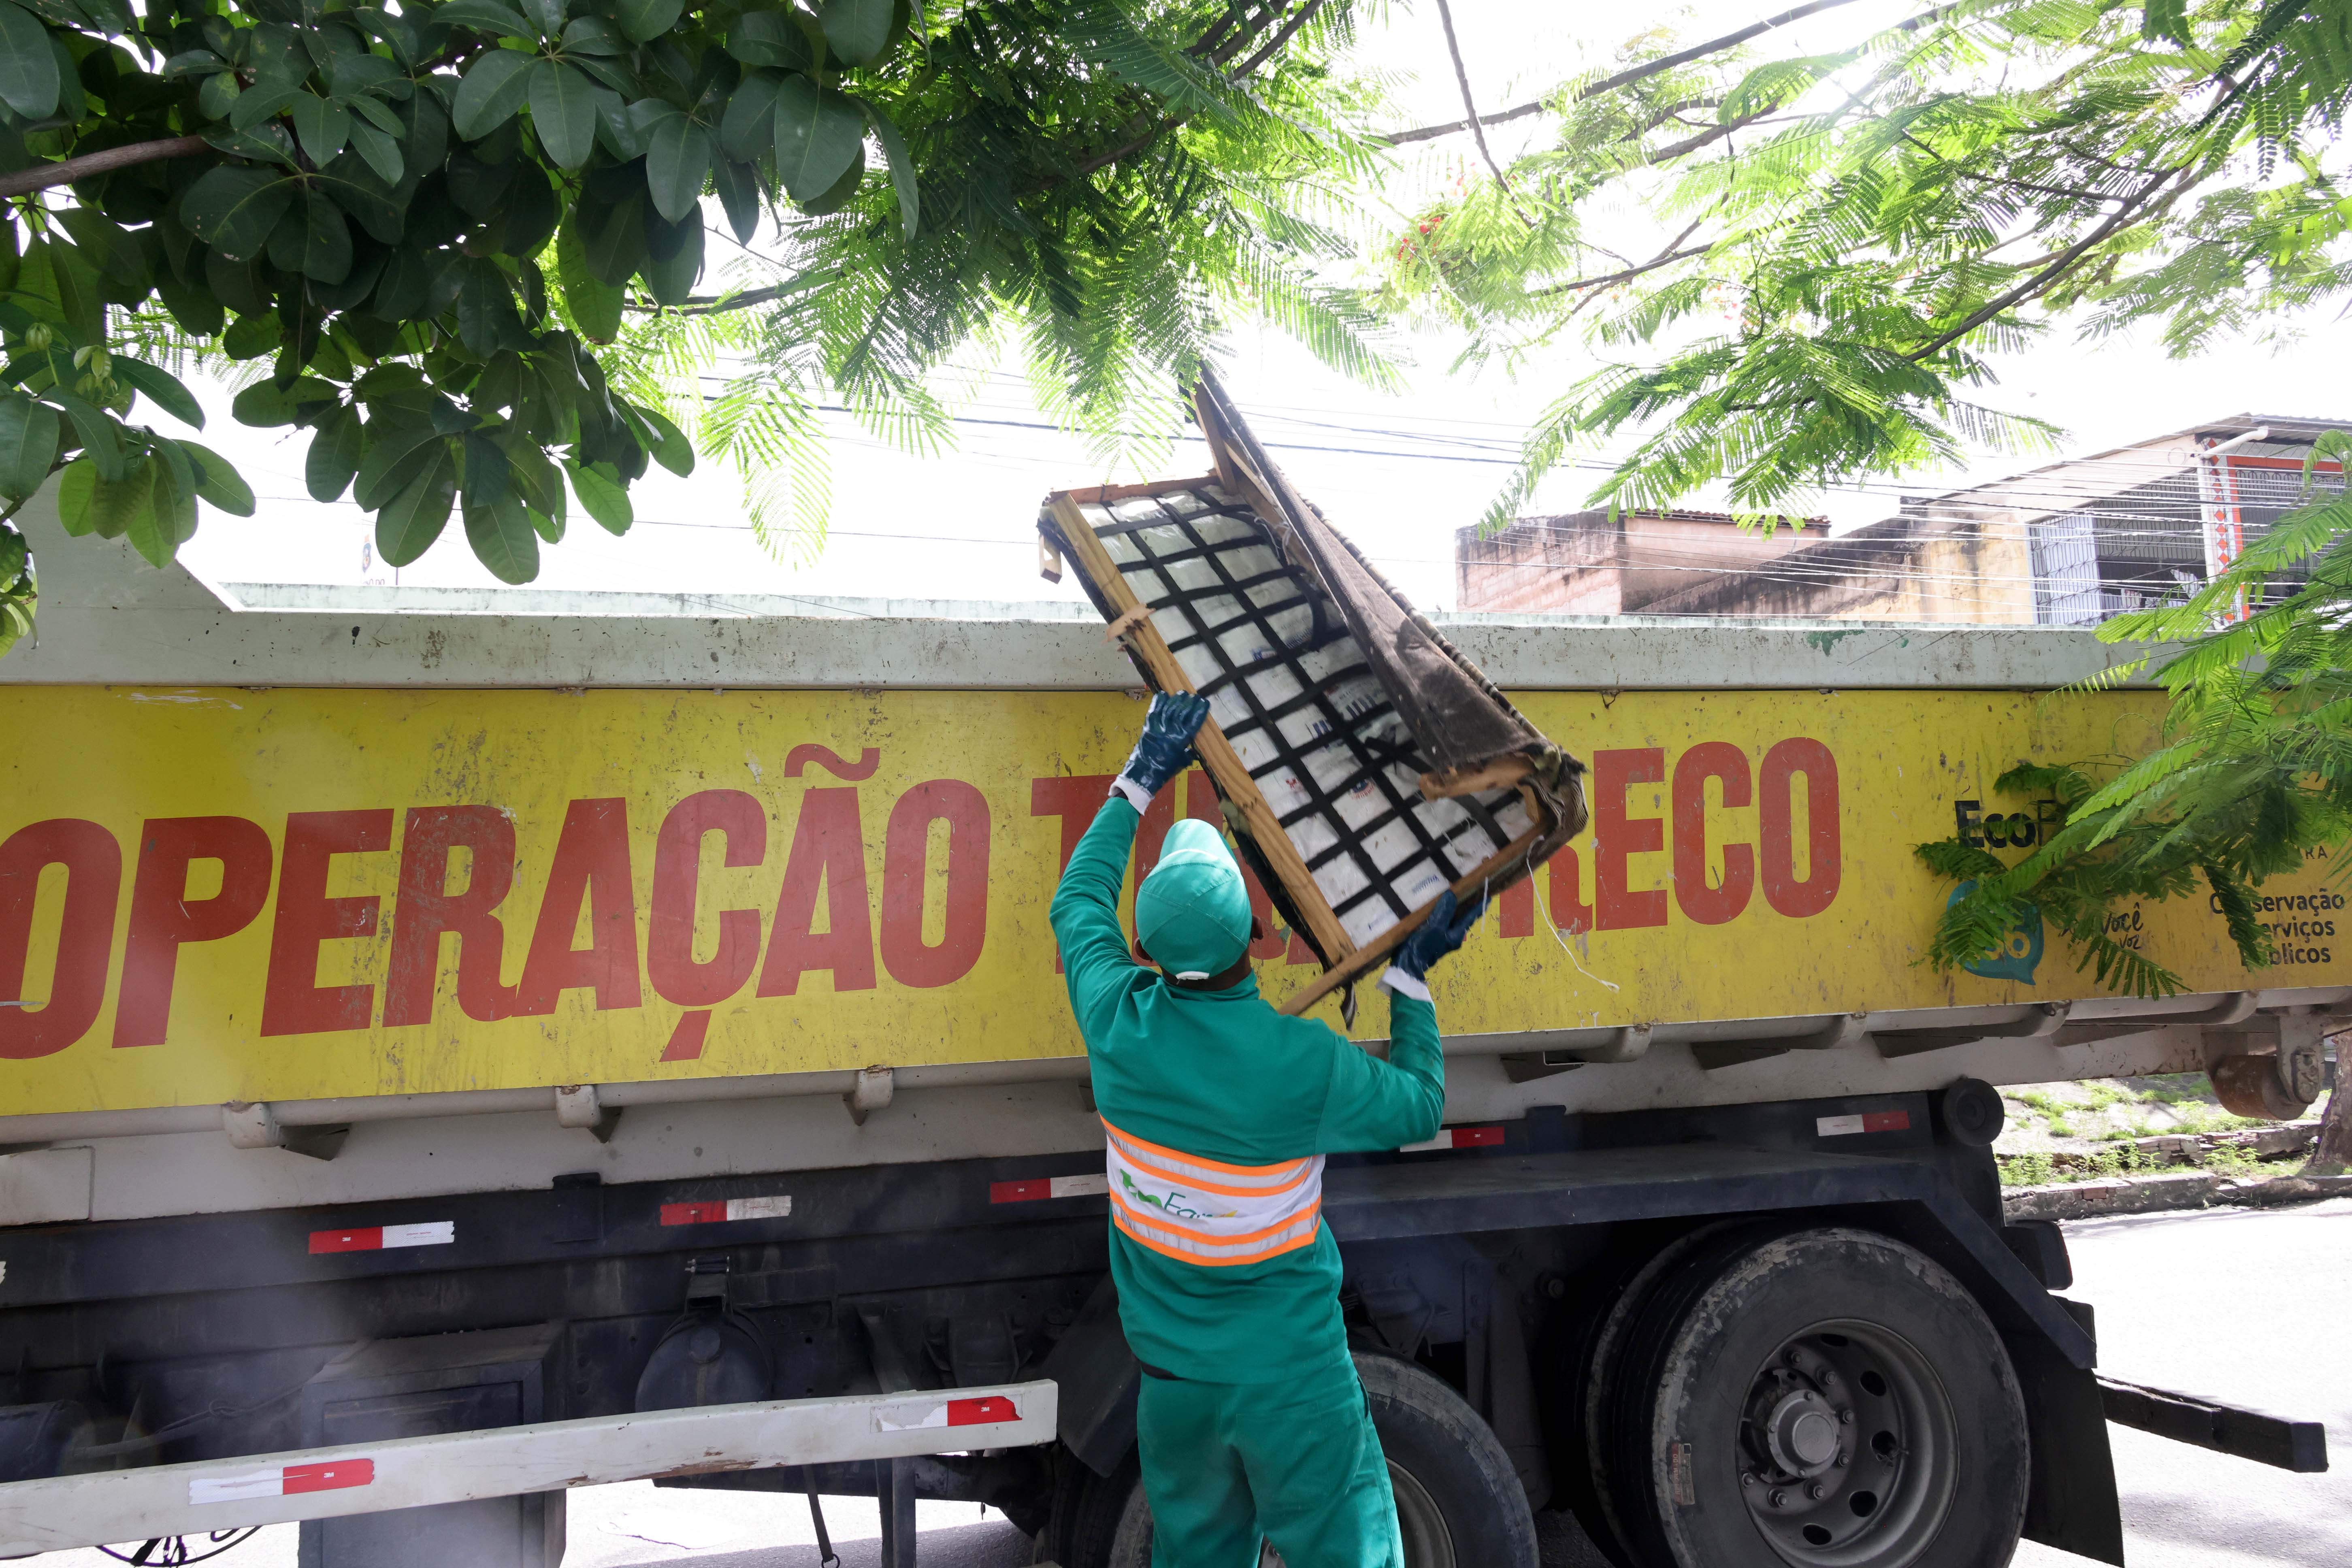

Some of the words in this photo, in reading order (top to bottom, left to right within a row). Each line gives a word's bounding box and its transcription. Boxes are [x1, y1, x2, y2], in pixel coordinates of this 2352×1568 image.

[1954, 799, 2058, 848] EcoF
[0, 744, 992, 1063] OPERAÇÃO
[1458, 737, 1842, 942] ECO
[2209, 888, 2345, 916] Cservação
[2261, 916, 2335, 944] rviços
